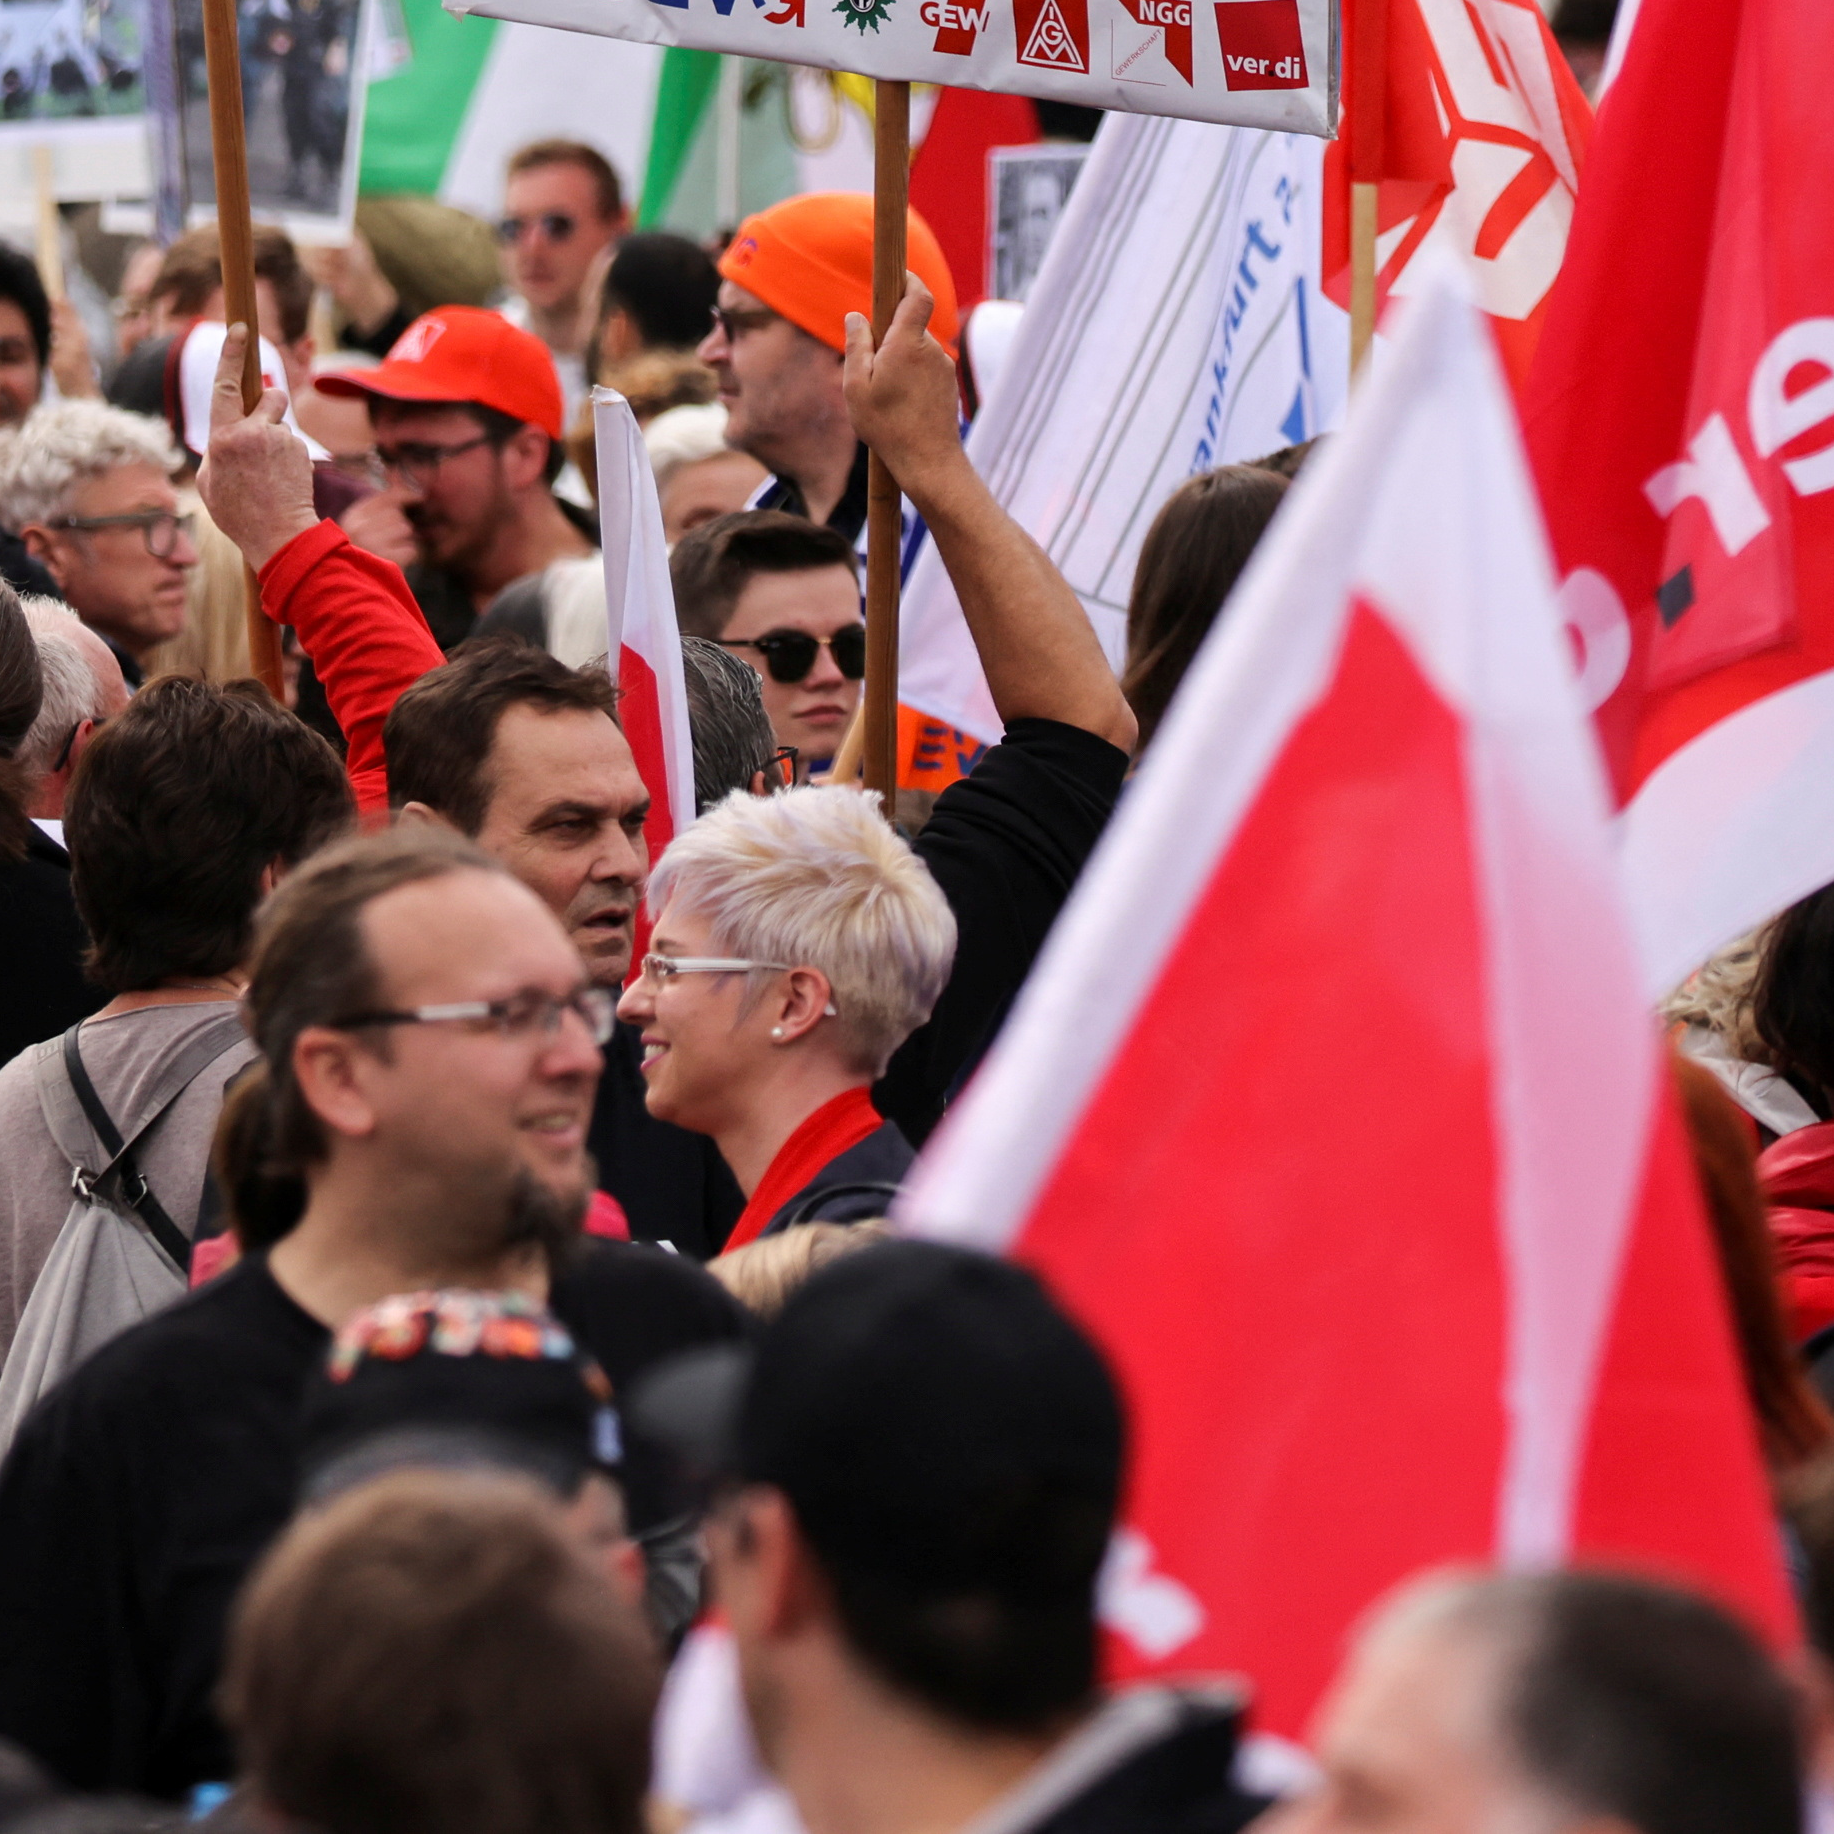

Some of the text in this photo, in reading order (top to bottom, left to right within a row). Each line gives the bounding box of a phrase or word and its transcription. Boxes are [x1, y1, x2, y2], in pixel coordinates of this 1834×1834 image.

[920, 1, 989, 32] GEW
[1139, 0, 1190, 26] NGG
[1115, 28, 1163, 77] GEWERKSCHAFT
[1227, 54, 1301, 80] ver.di
[914, 726, 988, 777] EV
